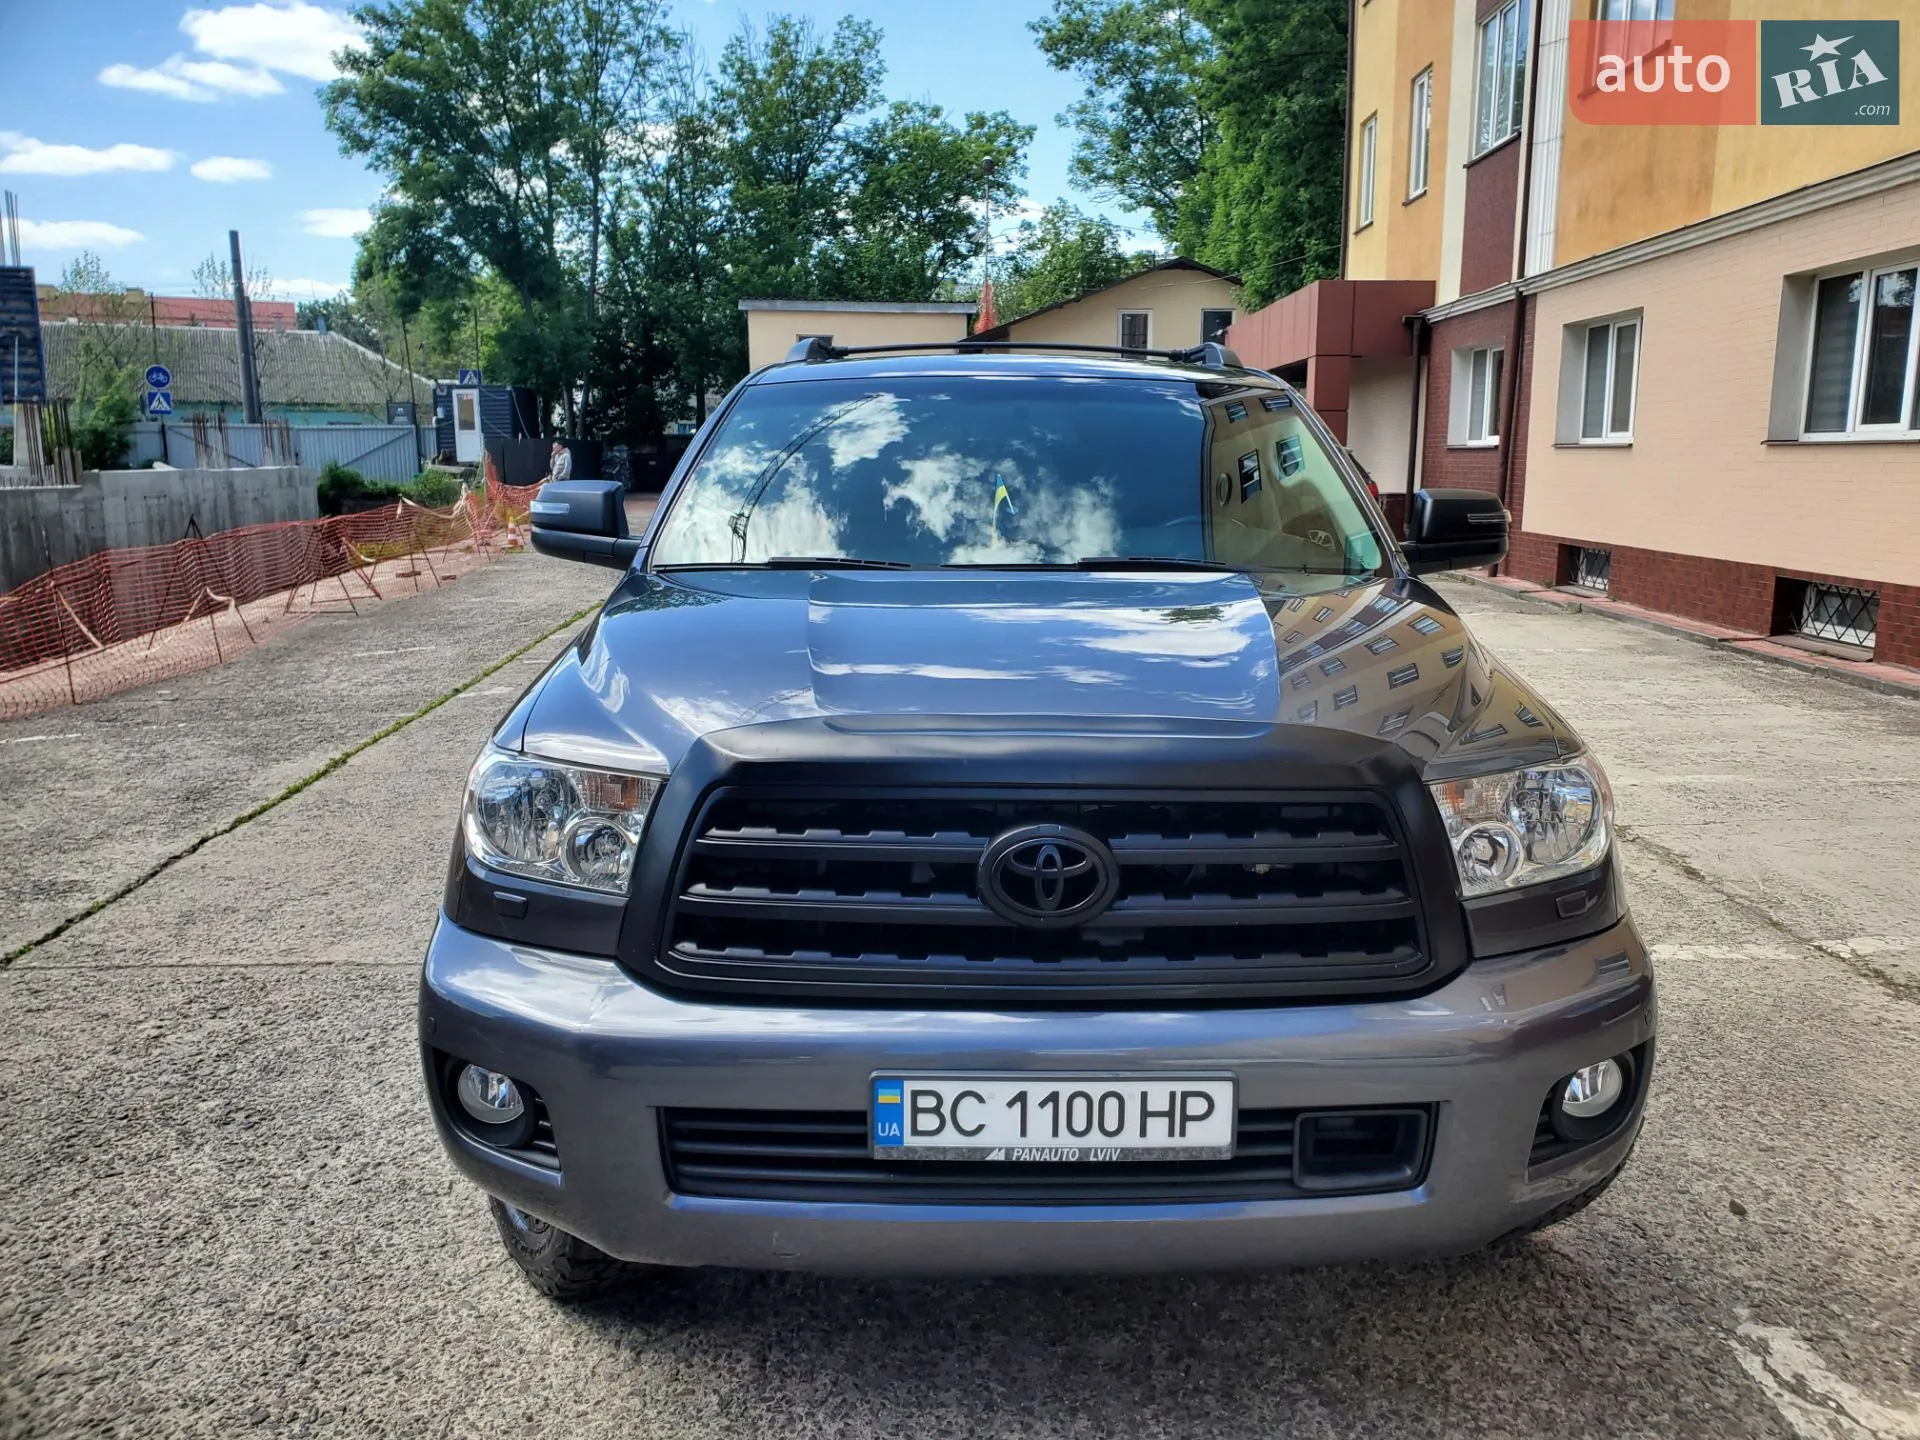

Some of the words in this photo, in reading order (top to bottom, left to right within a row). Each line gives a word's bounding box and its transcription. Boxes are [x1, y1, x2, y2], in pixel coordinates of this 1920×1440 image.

[910, 1089, 986, 1137] BC
[1005, 1090, 1126, 1138] 1100
[1139, 1090, 1215, 1138] HP
[878, 1123, 900, 1137] UA
[1012, 1148, 1079, 1161] PANAUTO
[1089, 1148, 1121, 1161] LVIV
